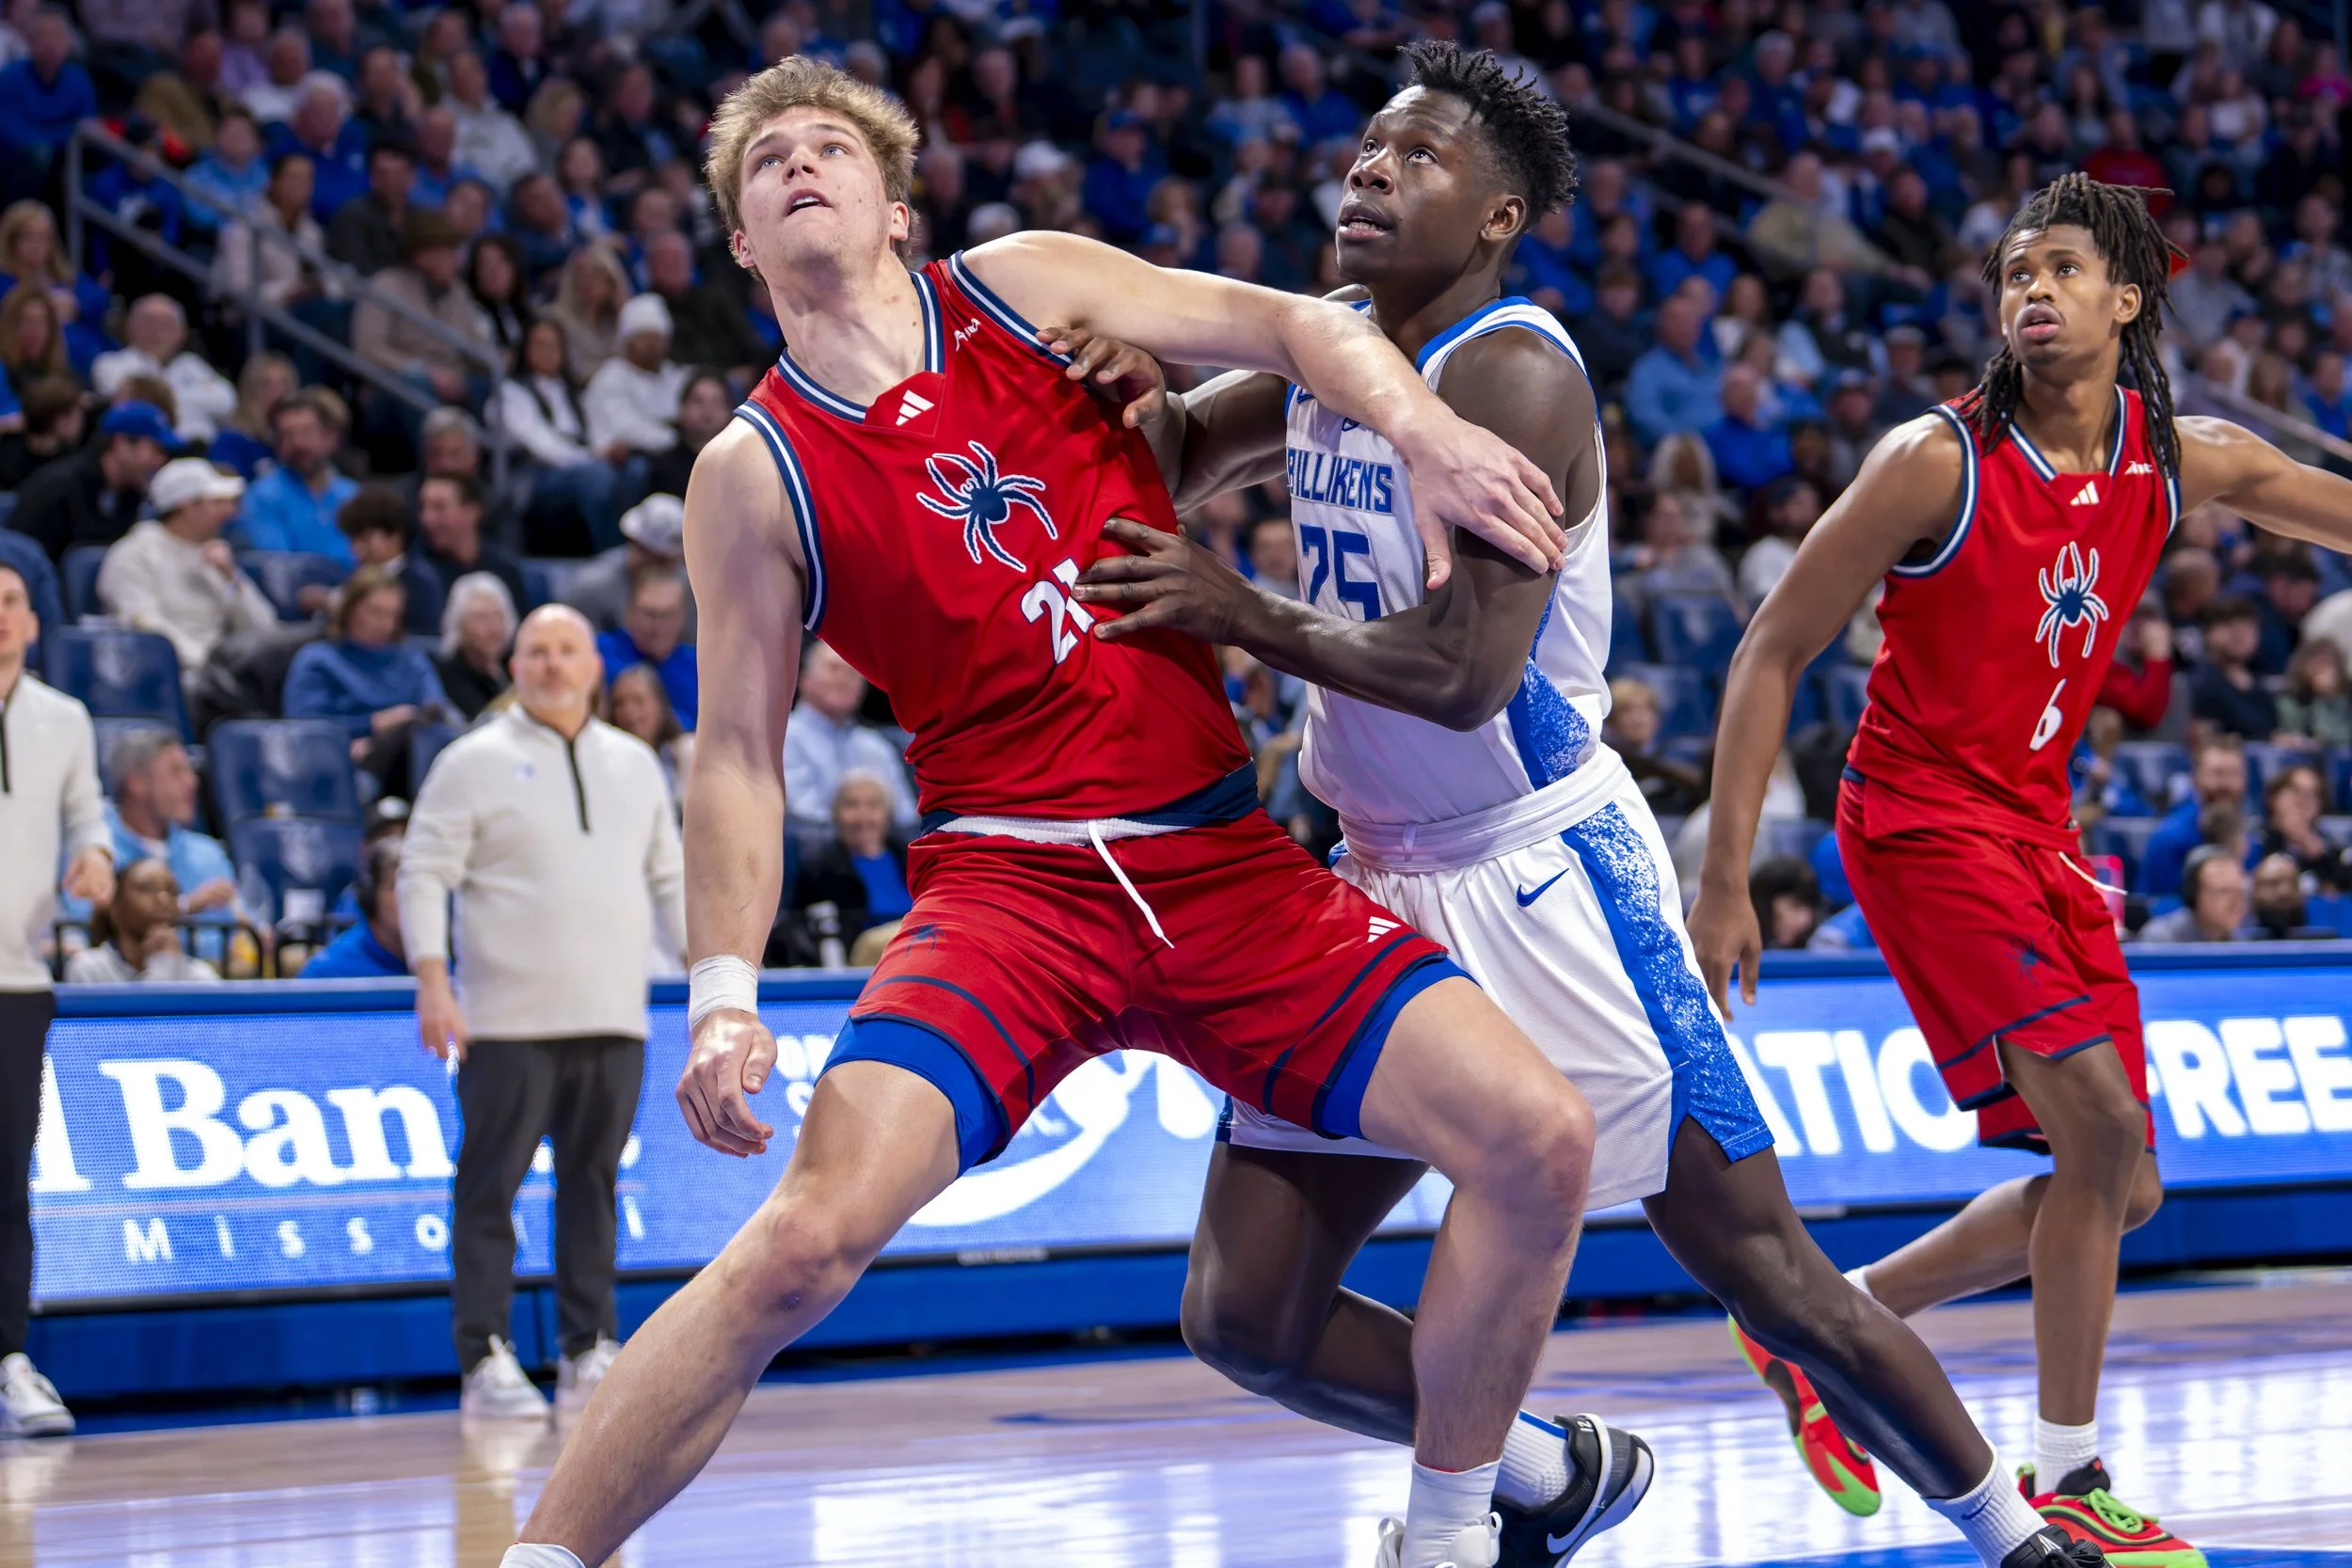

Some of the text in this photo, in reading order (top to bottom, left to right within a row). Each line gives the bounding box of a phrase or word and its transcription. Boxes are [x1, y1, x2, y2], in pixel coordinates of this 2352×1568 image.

[1287, 446, 1394, 515] BILLIKENS
[1020, 556, 1096, 666] 21
[2028, 677, 2068, 752] 6
[2146, 1016, 2352, 1141] REE
